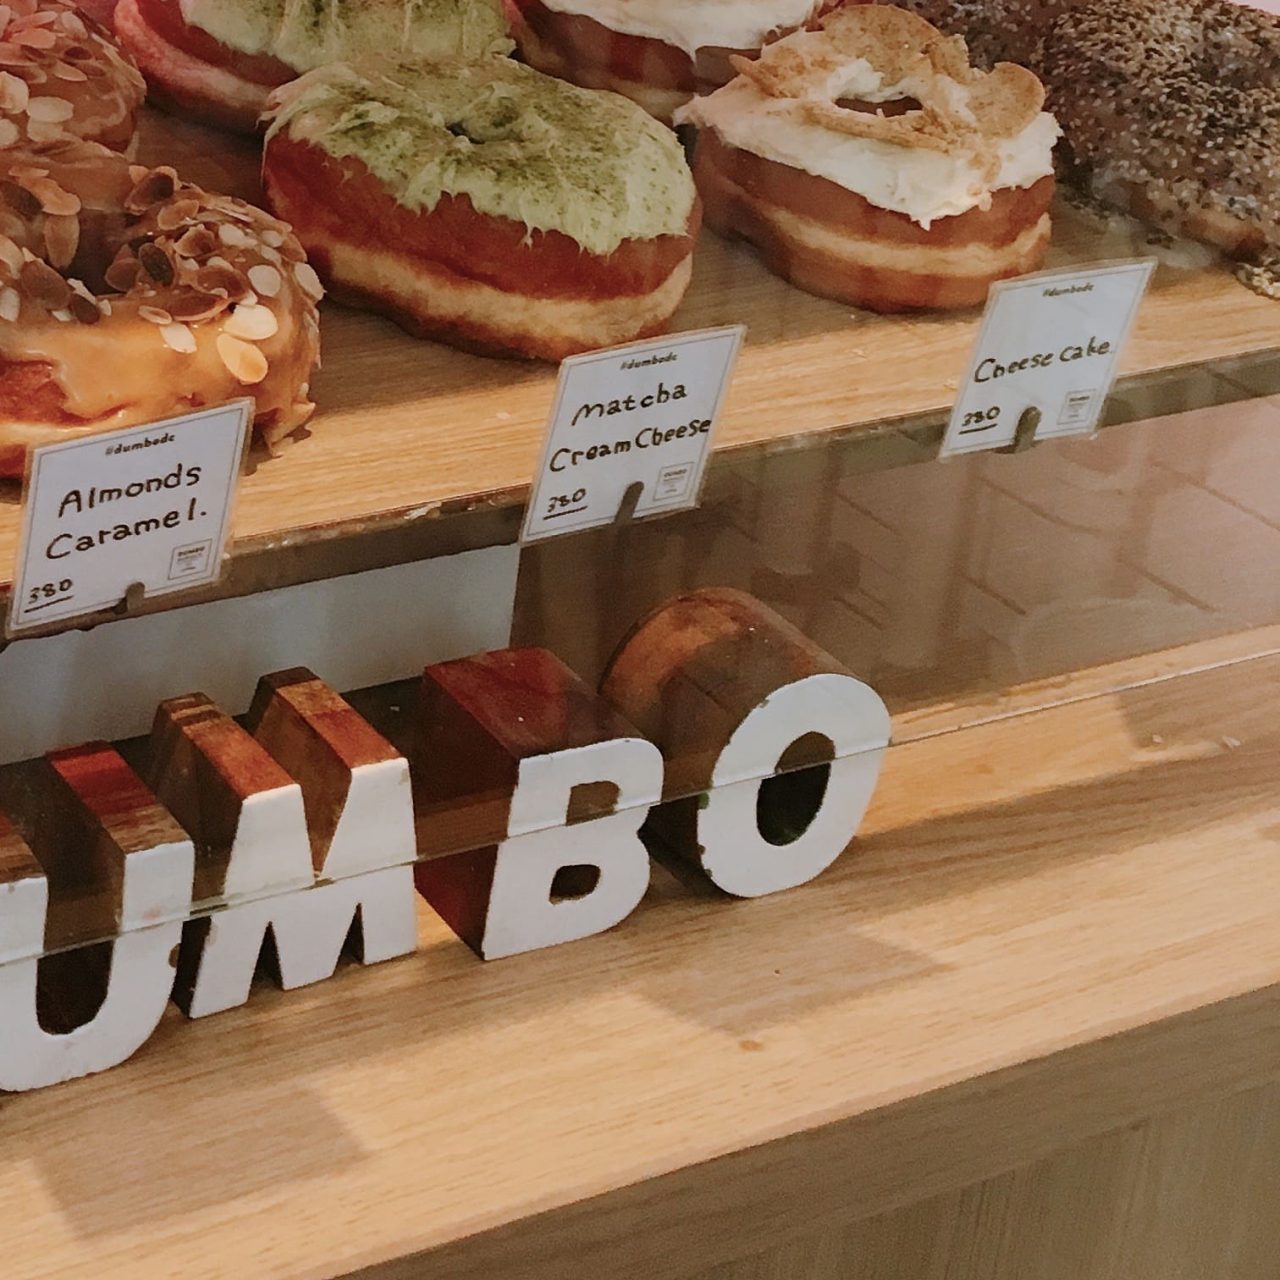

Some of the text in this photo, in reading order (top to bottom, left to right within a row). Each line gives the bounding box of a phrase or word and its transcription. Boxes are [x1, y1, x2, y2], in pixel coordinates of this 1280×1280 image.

[620, 352, 677, 370] #dumbodc
[974, 352, 1054, 383] Cheese
[105, 433, 176, 456] #dumbodc
[58, 463, 202, 518] Almonds
[547, 488, 586, 513] 380
[45, 498, 207, 560] Caramel.
[28, 578, 73, 604] 380
